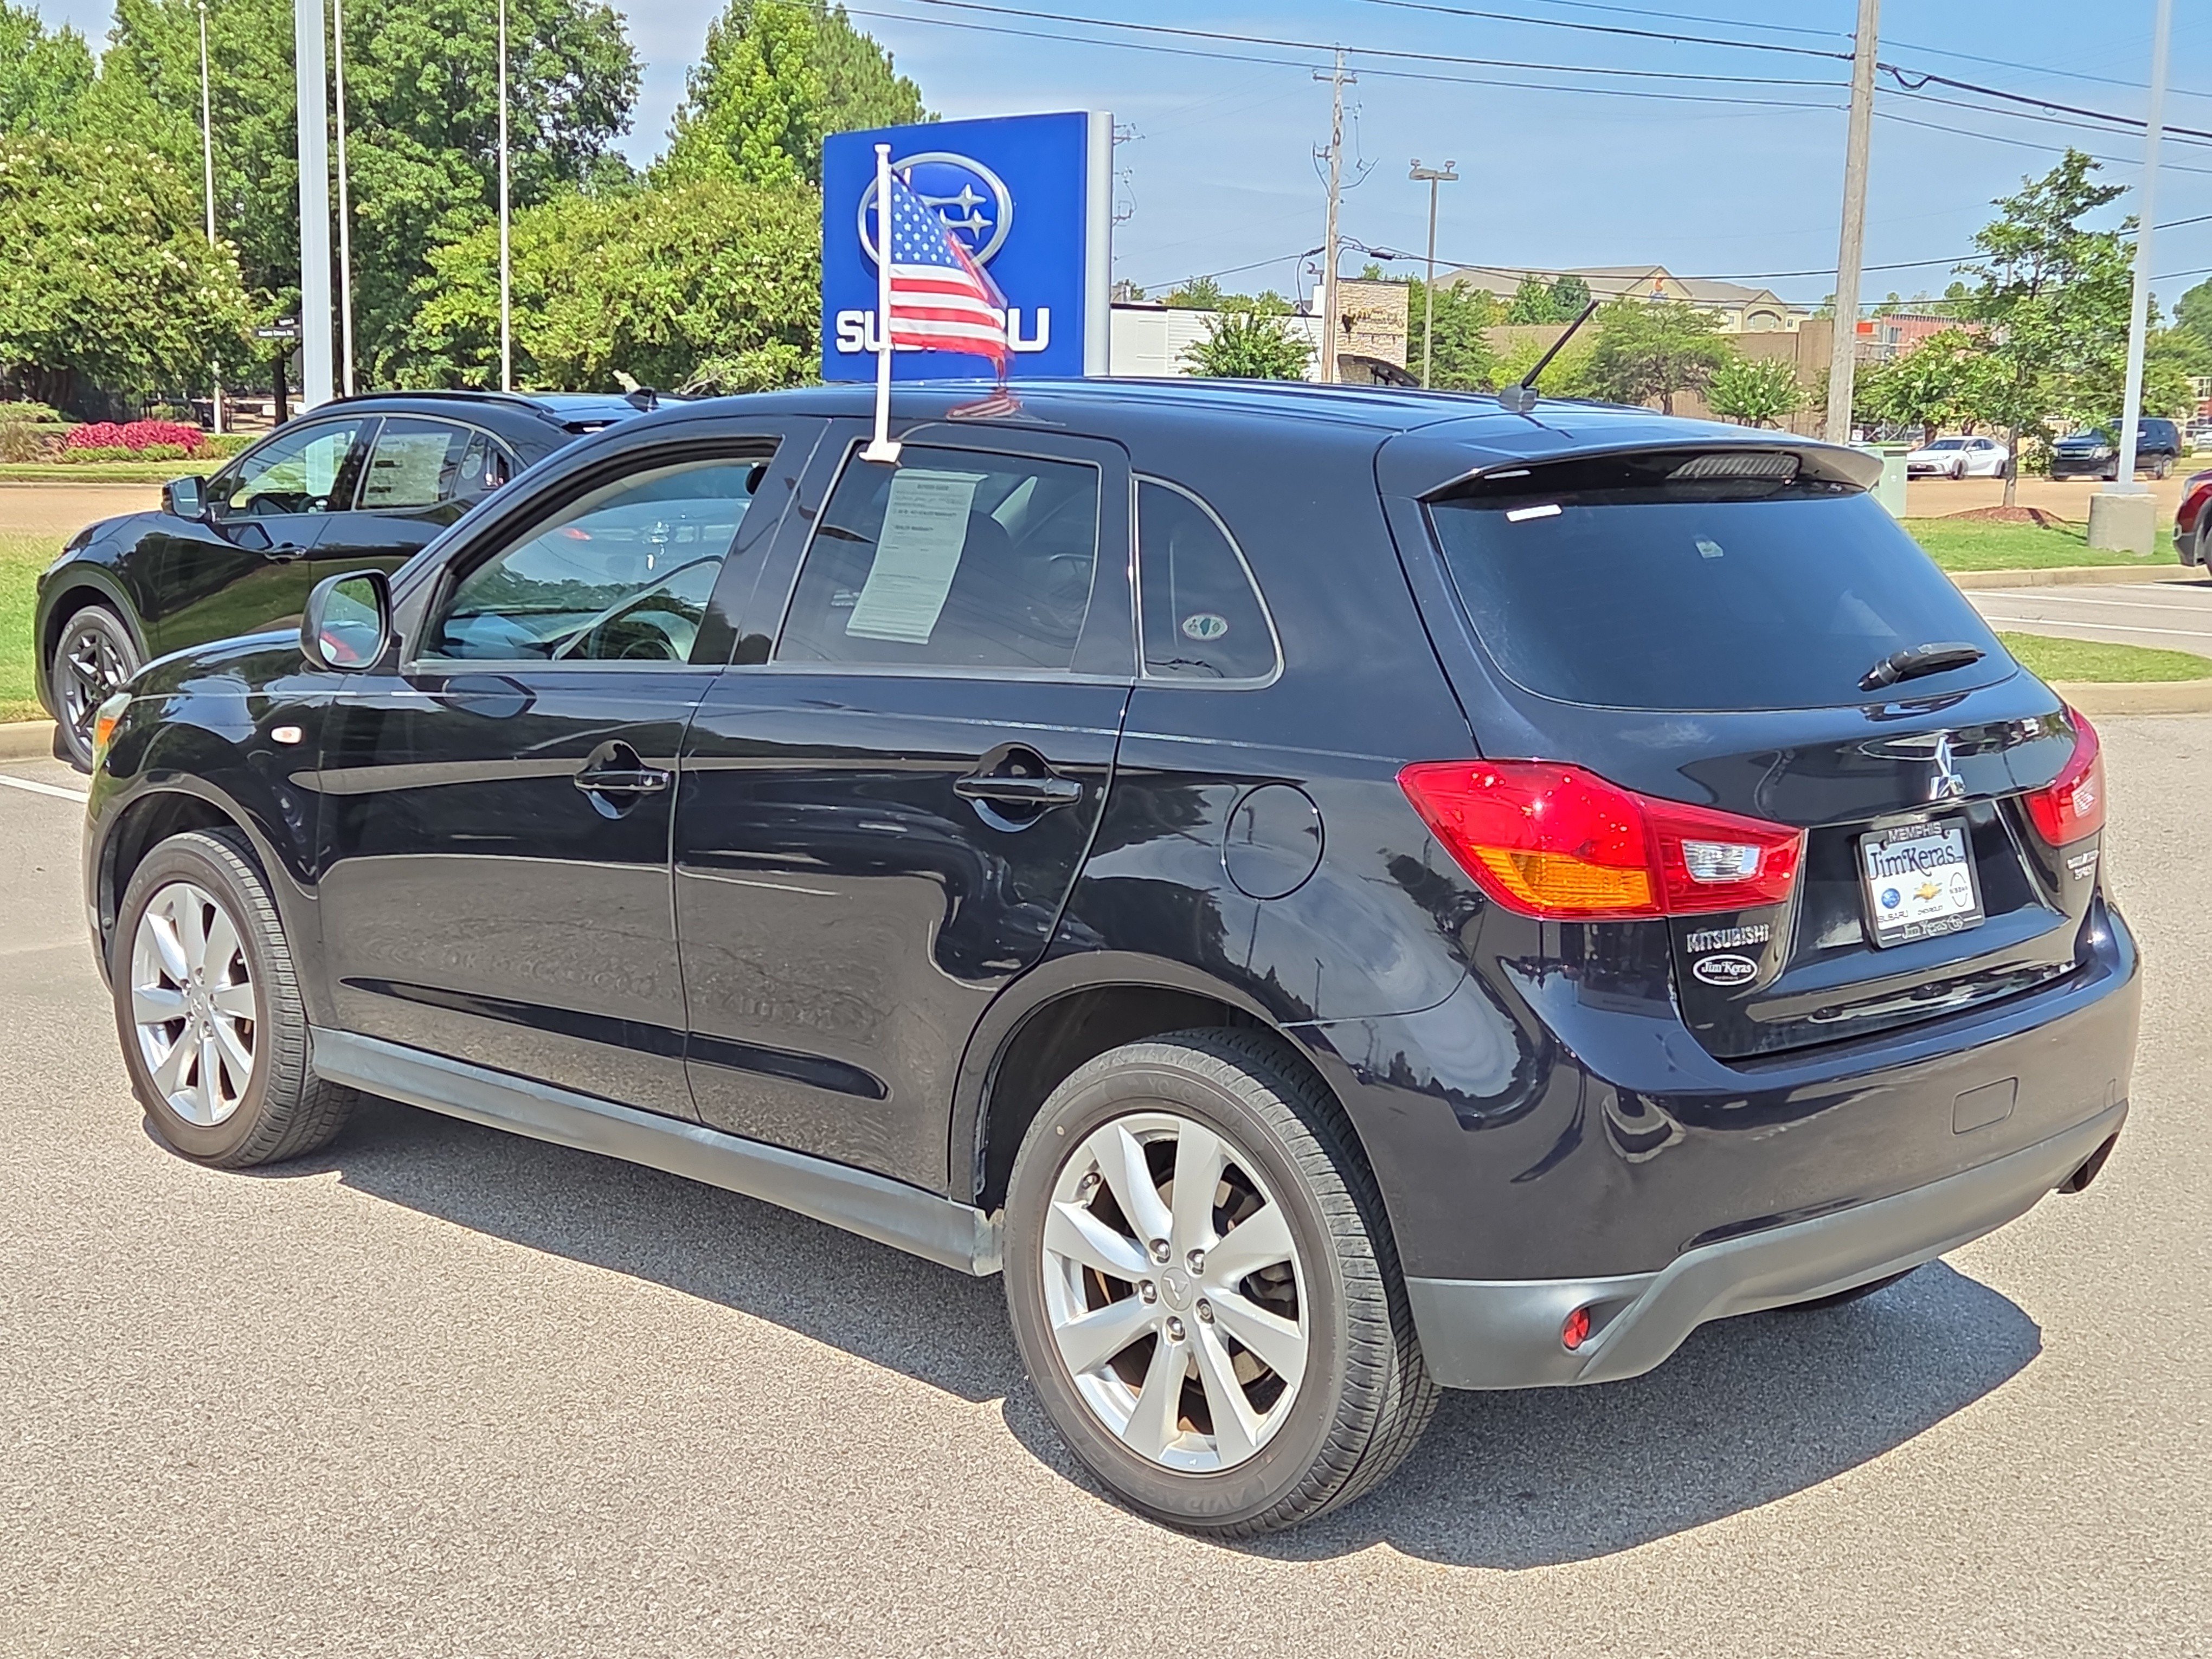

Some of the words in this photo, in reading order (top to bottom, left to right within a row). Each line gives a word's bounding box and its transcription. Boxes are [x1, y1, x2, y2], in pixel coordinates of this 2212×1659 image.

[1888, 821, 1943, 843] MEMPHIS
[1687, 923, 1770, 953] MITSUBISHI
[1701, 961, 1722, 973] Jim
[1721, 961, 1752, 976] Keras
